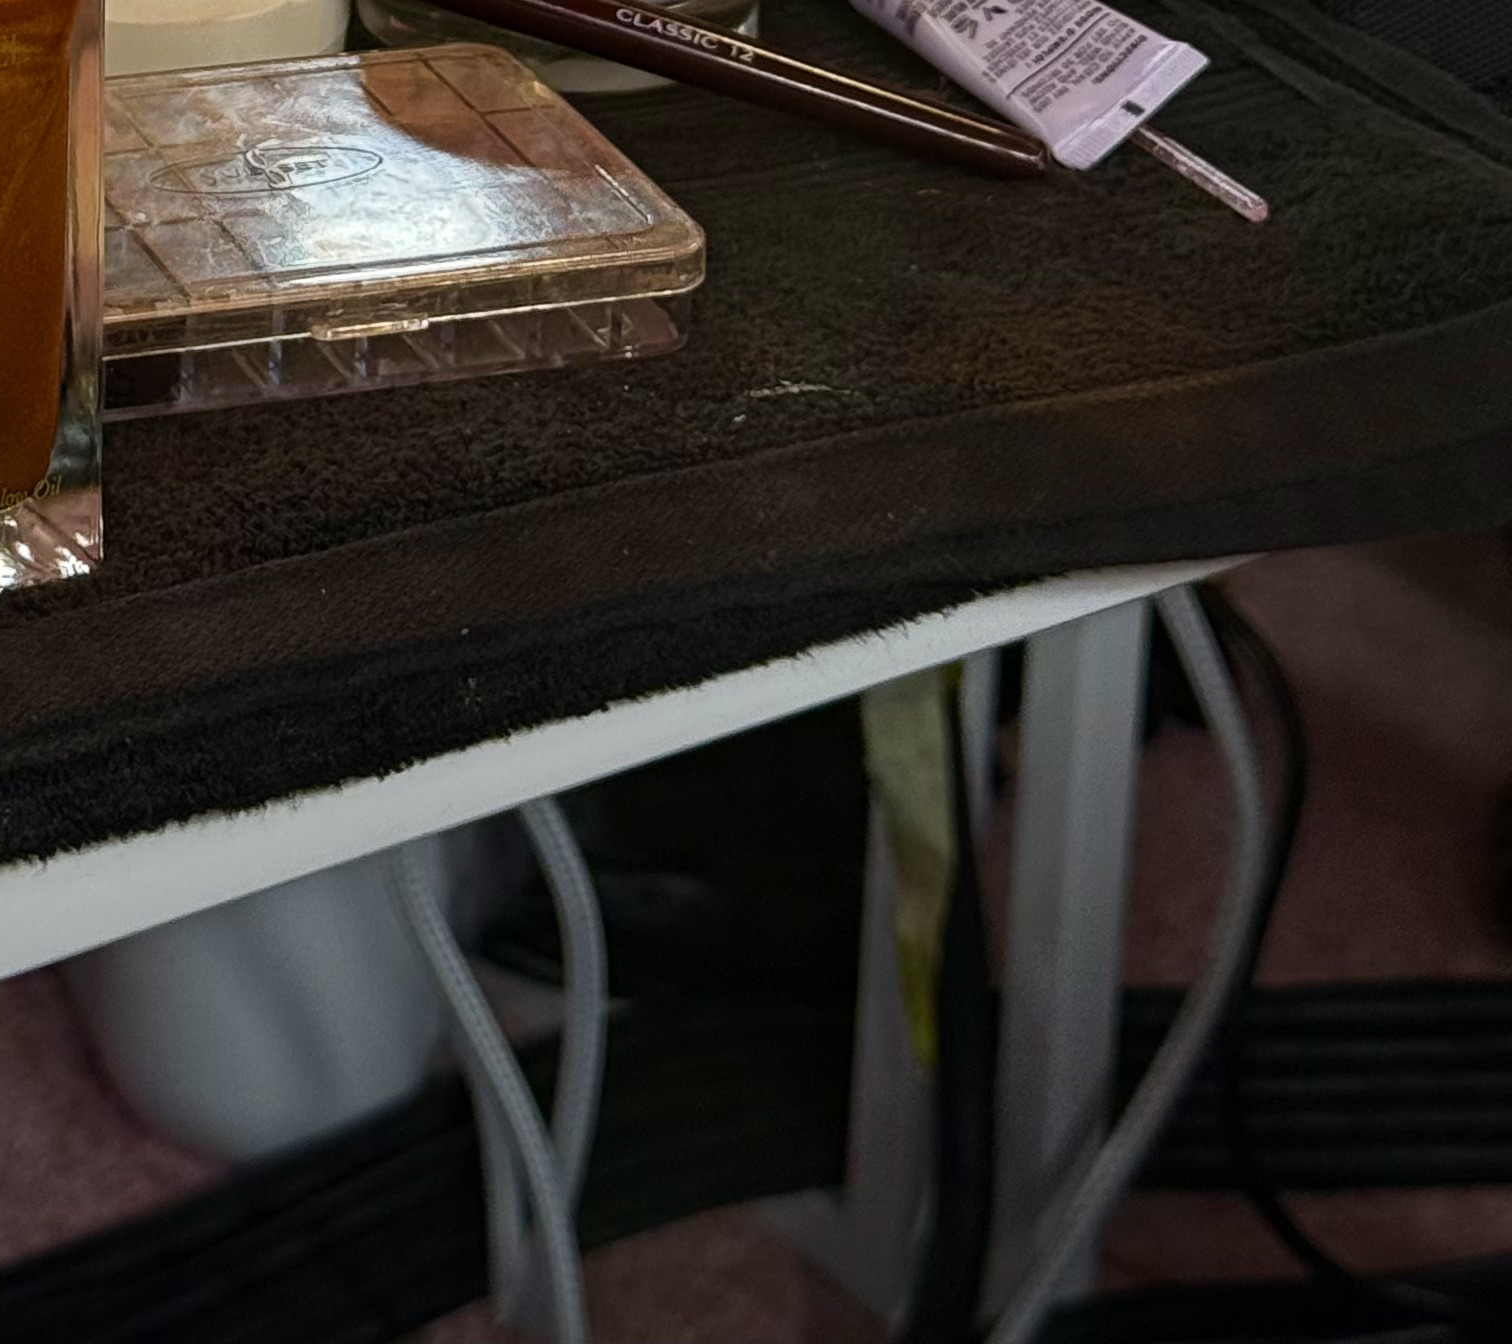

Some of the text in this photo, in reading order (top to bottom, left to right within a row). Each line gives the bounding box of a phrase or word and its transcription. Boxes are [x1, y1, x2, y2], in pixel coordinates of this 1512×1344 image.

[615, 8, 755, 63] CLASSIC 12
[33, 475, 63, 501] Oil
